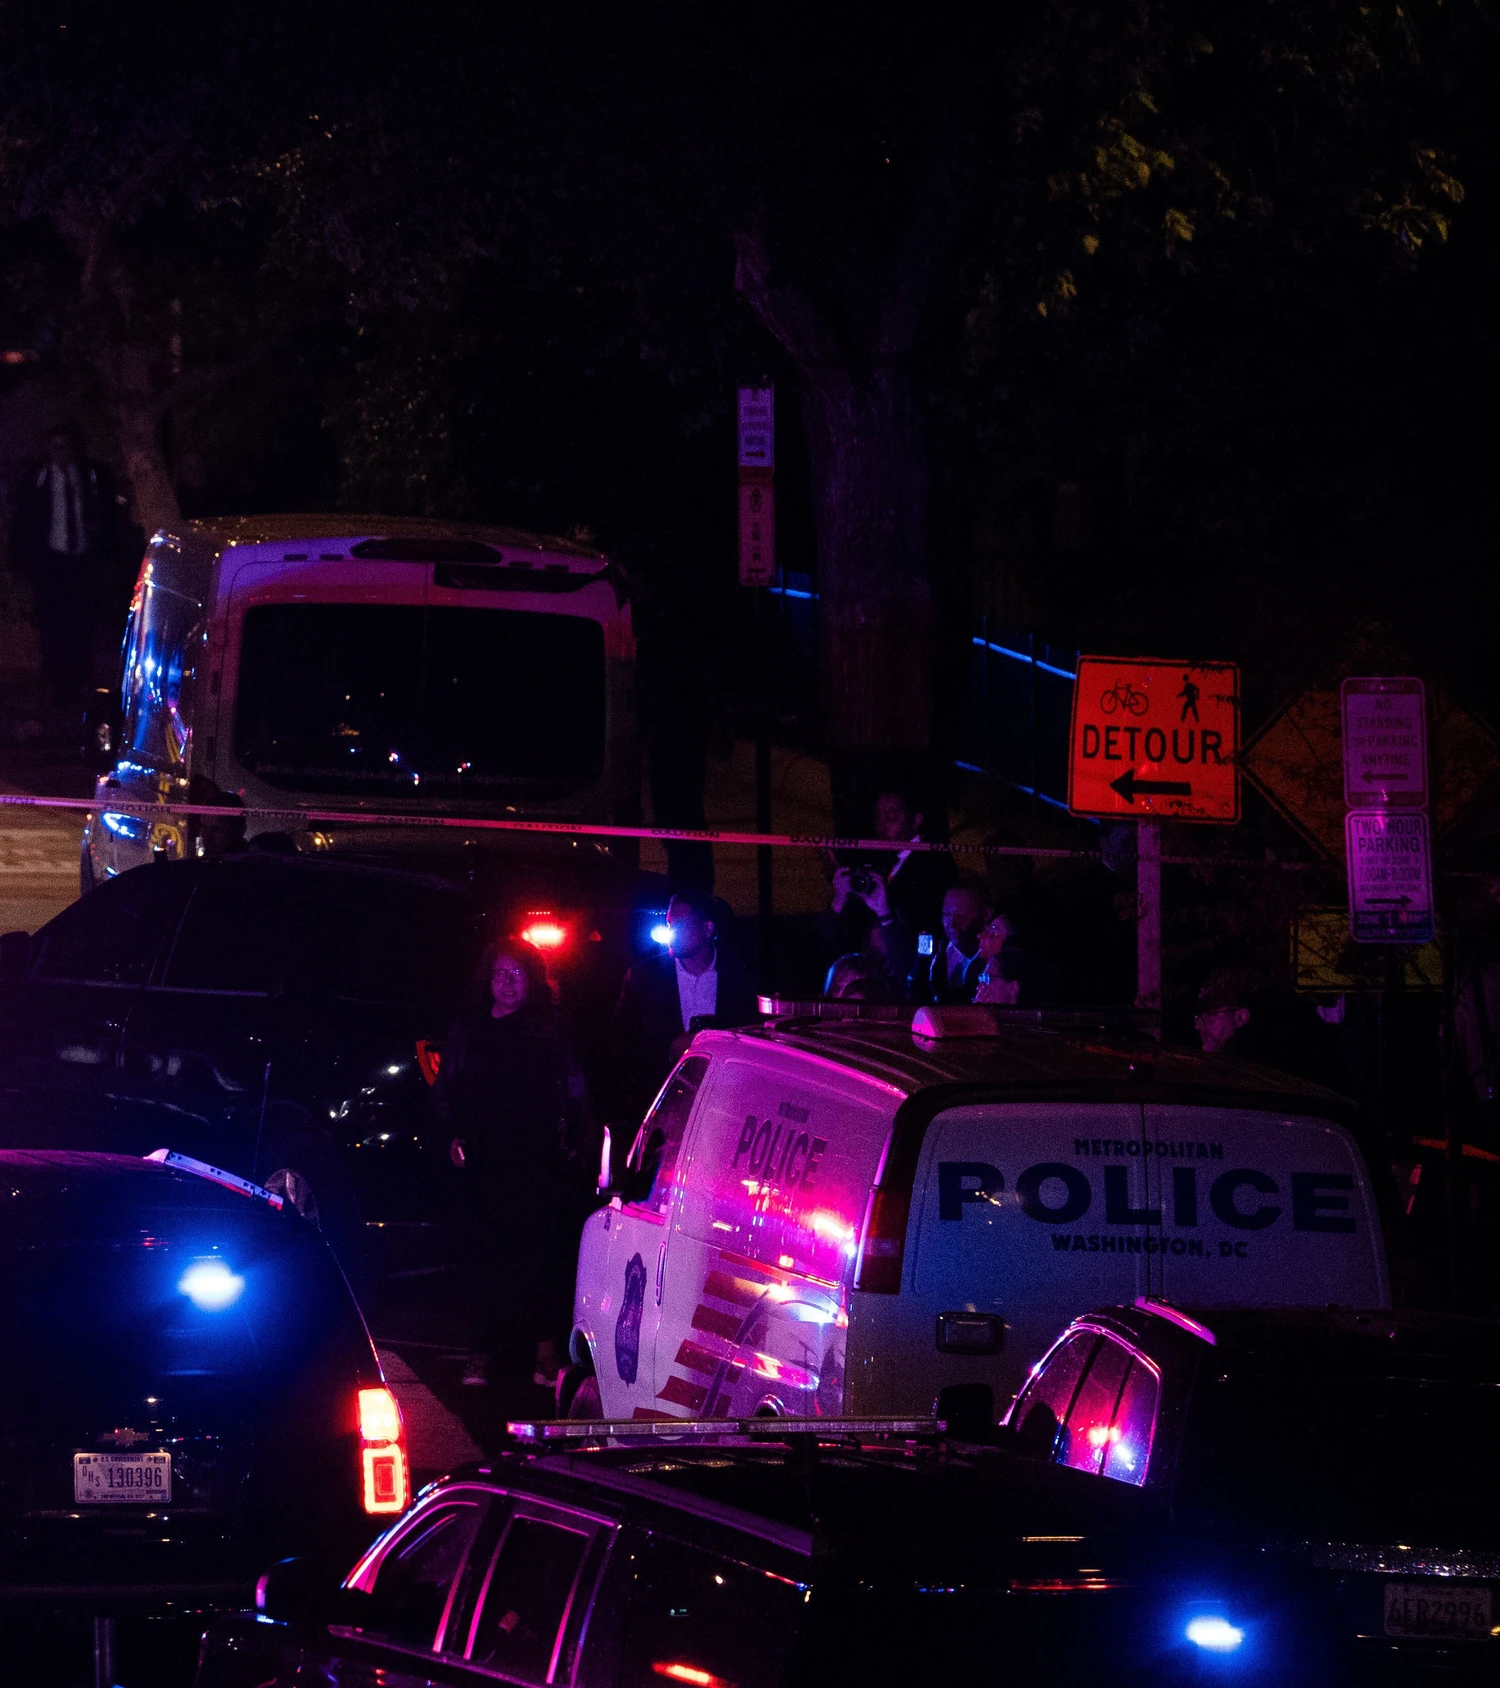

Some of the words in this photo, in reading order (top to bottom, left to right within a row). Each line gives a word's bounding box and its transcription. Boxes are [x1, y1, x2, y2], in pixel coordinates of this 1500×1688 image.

[1082, 724, 1223, 765] DETOUR
[1353, 818, 1382, 835] TWO
[1385, 818, 1423, 835] HOUR
[790, 835, 859, 848] CAUTION
[1357, 836, 1421, 853] PARKING
[731, 1113, 829, 1188] POLICE
[1073, 1138, 1225, 1160] METROPOLITAN
[937, 1160, 1357, 1234] POLICE
[1049, 1233, 1212, 1258] WASHINGTON,
[1218, 1239, 1249, 1258] DC
[108, 1467, 162, 1488] 130396
